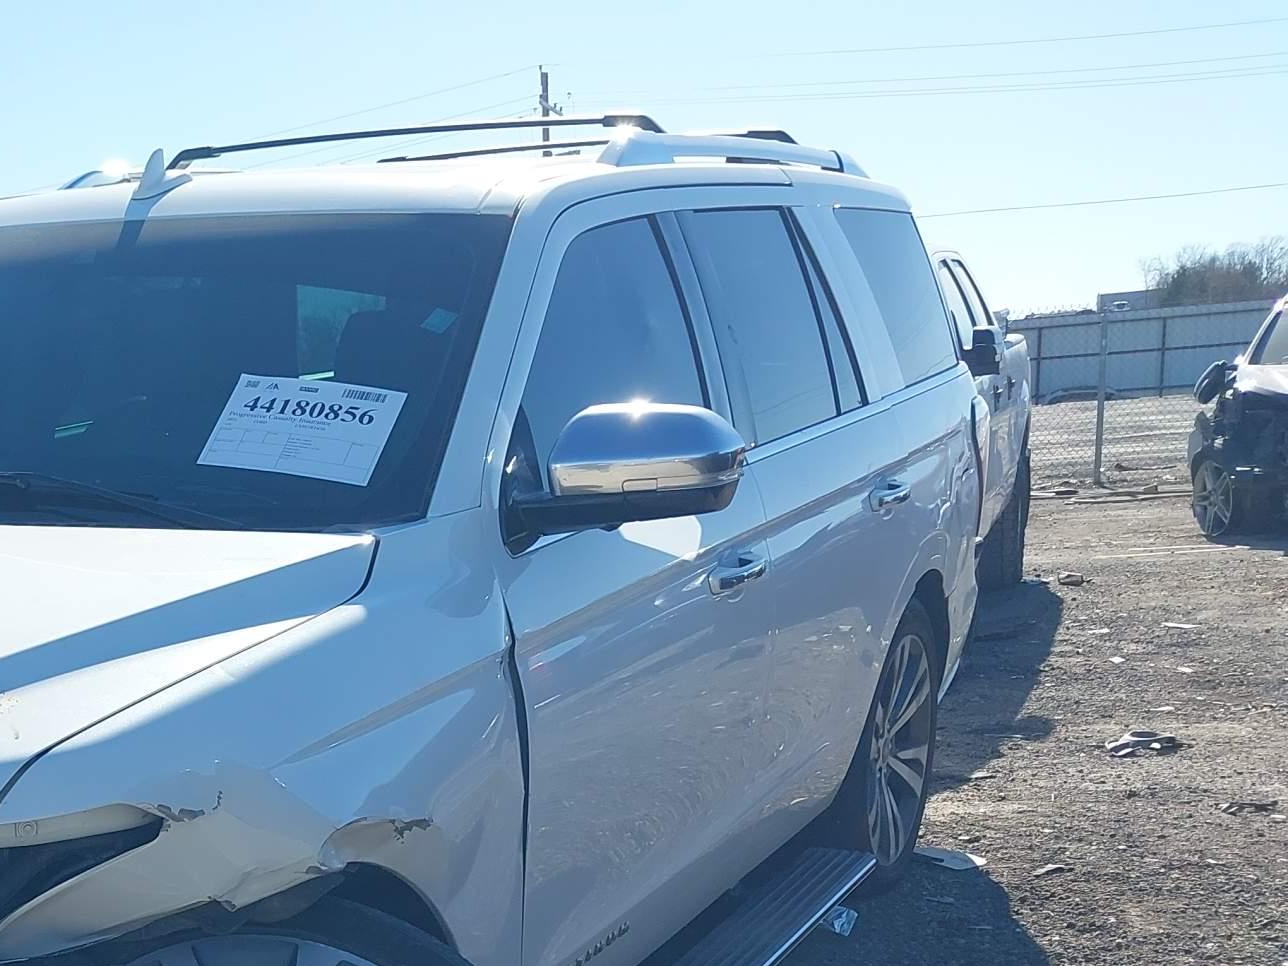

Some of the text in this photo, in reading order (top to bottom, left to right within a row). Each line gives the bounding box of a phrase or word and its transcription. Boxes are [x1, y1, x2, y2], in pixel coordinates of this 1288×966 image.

[228, 410, 331, 427] Progressive Casualty Insurance
[243, 395, 378, 426] 44180856
